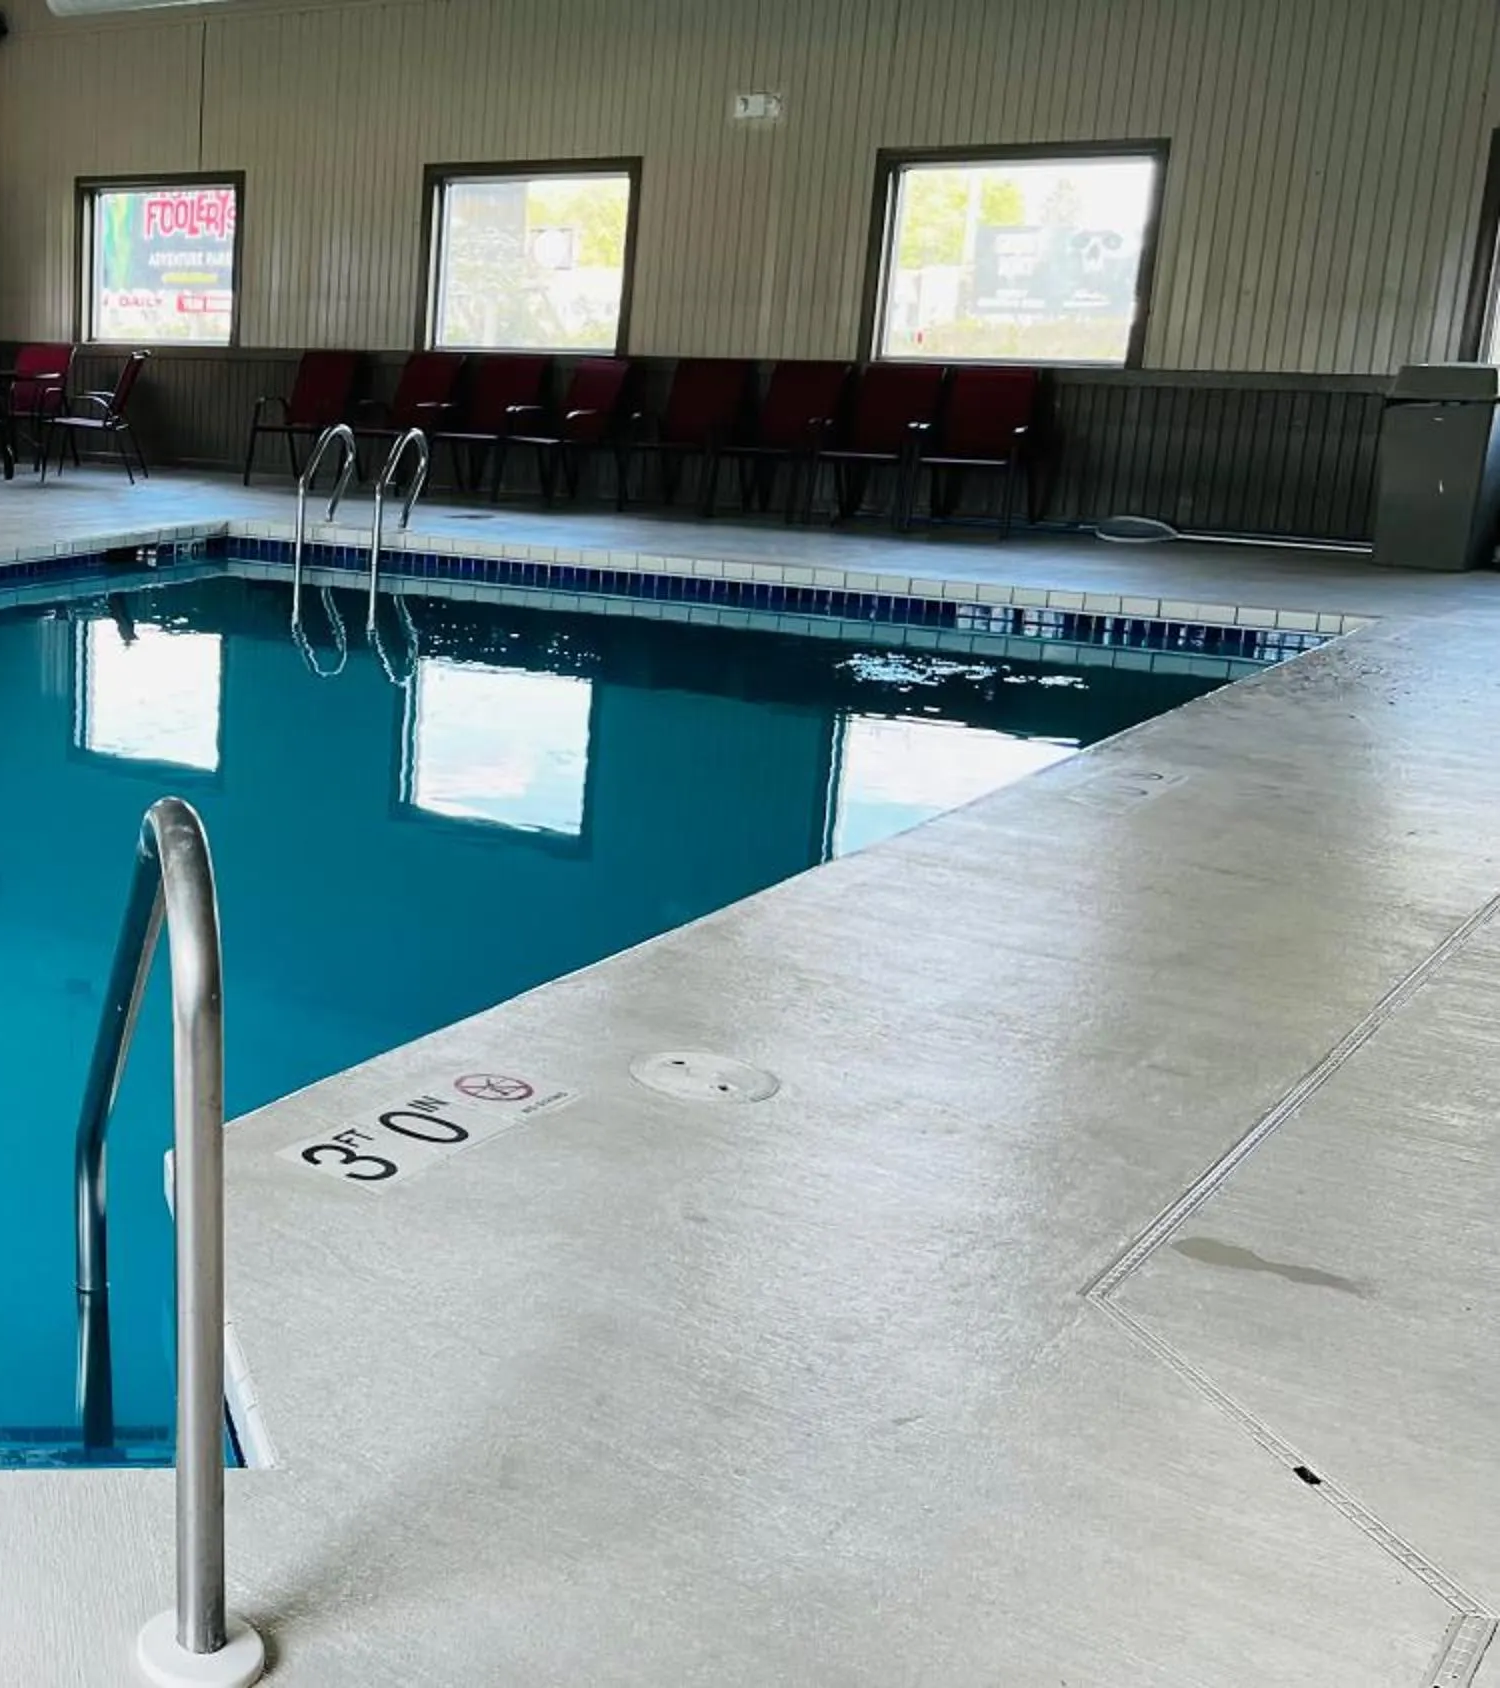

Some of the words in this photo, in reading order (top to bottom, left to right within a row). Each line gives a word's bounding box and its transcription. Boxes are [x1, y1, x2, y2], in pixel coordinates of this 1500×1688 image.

[406, 1095, 450, 1113] IN
[332, 1128, 375, 1148] FT
[378, 1111, 469, 1144] 0
[301, 1143, 398, 1181] 3
